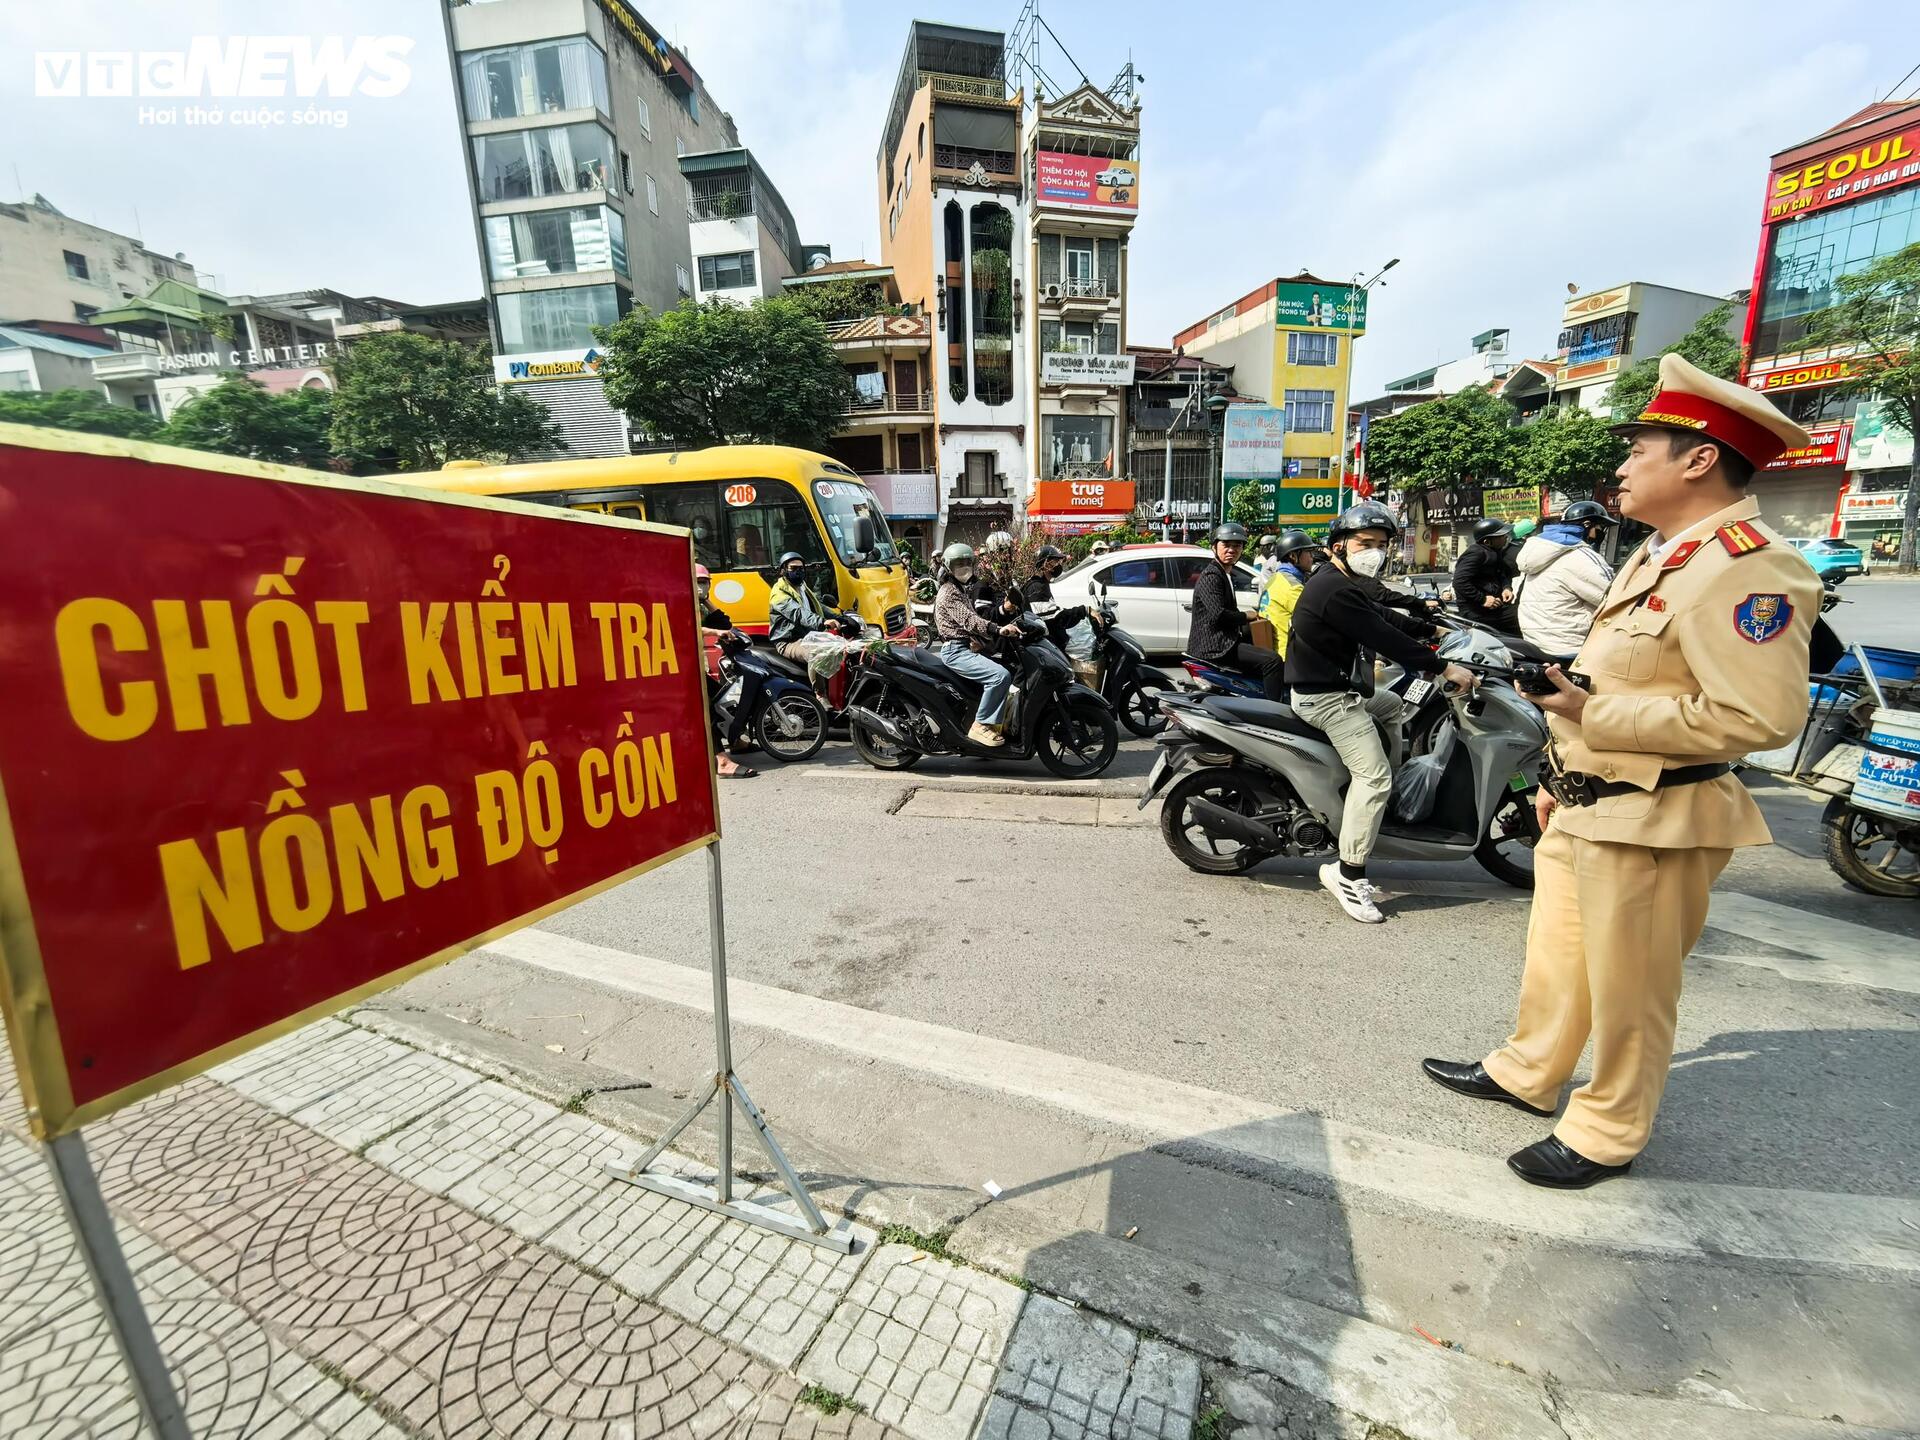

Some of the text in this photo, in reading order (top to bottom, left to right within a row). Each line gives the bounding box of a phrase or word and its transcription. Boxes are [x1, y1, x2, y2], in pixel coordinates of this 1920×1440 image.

[1042, 166, 1061, 174] THÊM
[1775, 136, 1914, 199] SEOUL
[1041, 177, 1062, 185] CỘNG
[1076, 180, 1091, 188] TÂM
[1792, 195, 1813, 212] CAY
[1827, 181, 1850, 201] CẤP
[158, 342, 328, 370] FASHION CENTER
[509, 360, 585, 378] PVcomBank
[1806, 448, 1822, 457] CHI
[728, 485, 754, 503] 208
[1070, 482, 1105, 496] true
[1070, 496, 1105, 508] money
[1460, 505, 1480, 516] ACE
[55, 554, 680, 742] CHỐT KIỂM TRA
[159, 711, 677, 971] NỒNG ĐỘ CỒN
